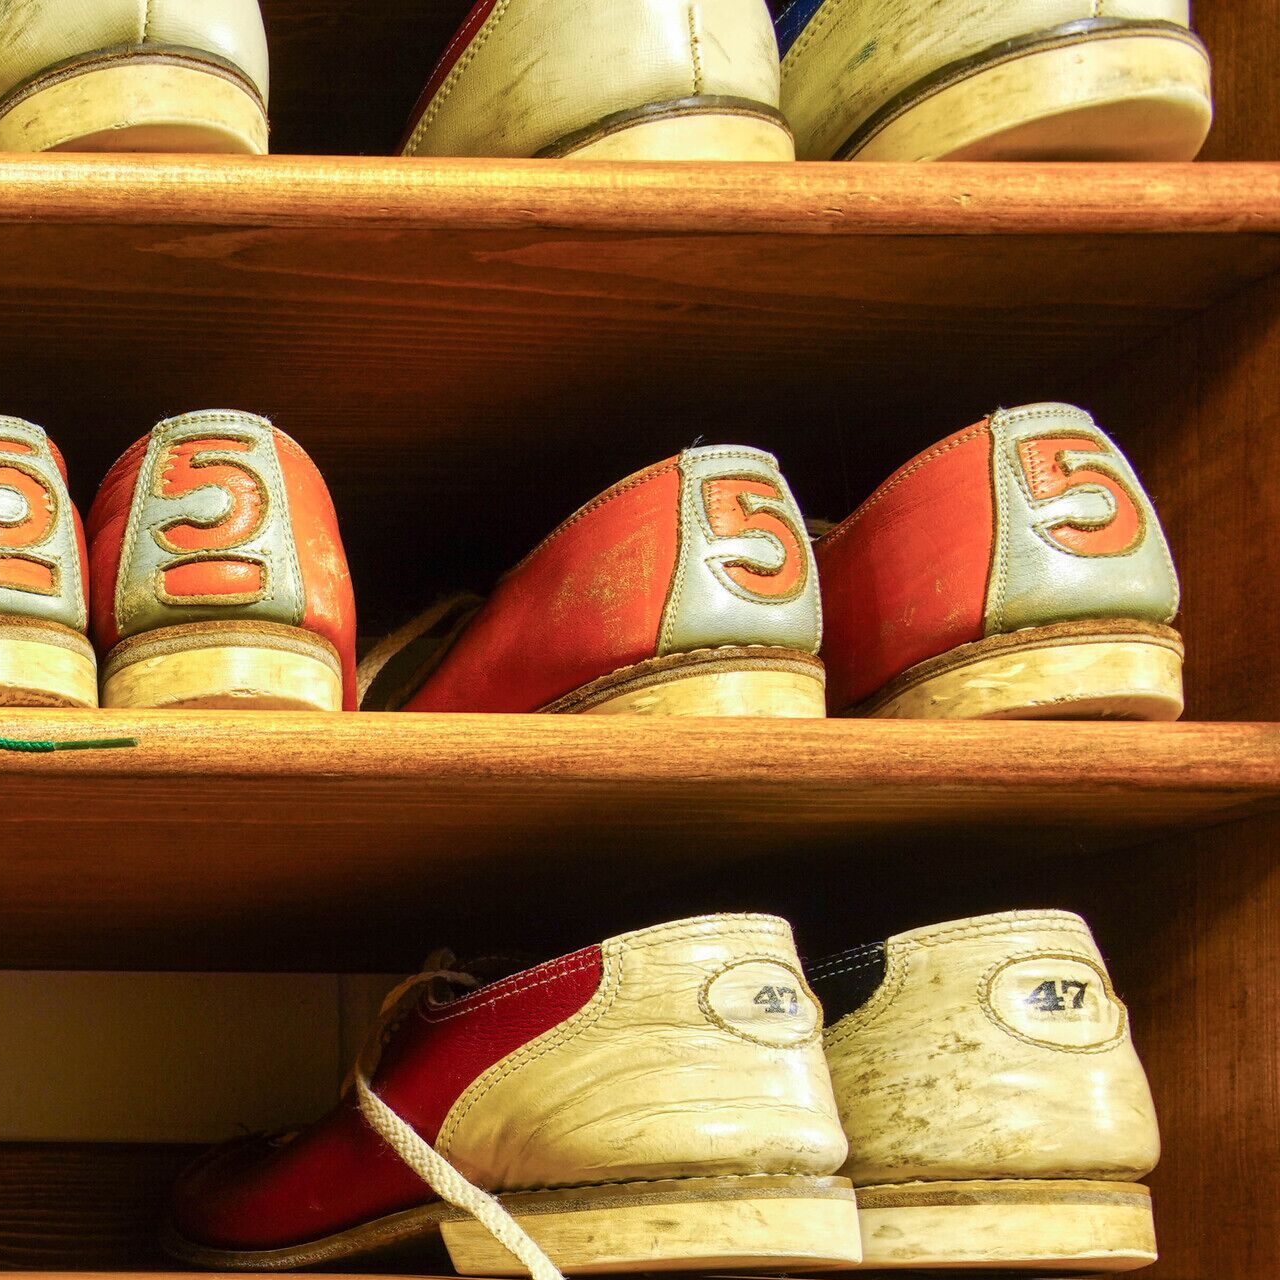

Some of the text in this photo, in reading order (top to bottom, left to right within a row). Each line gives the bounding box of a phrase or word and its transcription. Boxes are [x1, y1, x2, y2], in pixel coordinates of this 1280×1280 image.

[152, 432, 268, 553] 5
[701, 472, 807, 601] 5
[1015, 428, 1147, 556] 5
[752, 985, 799, 1015] 47
[1023, 981, 1087, 1011] 47
